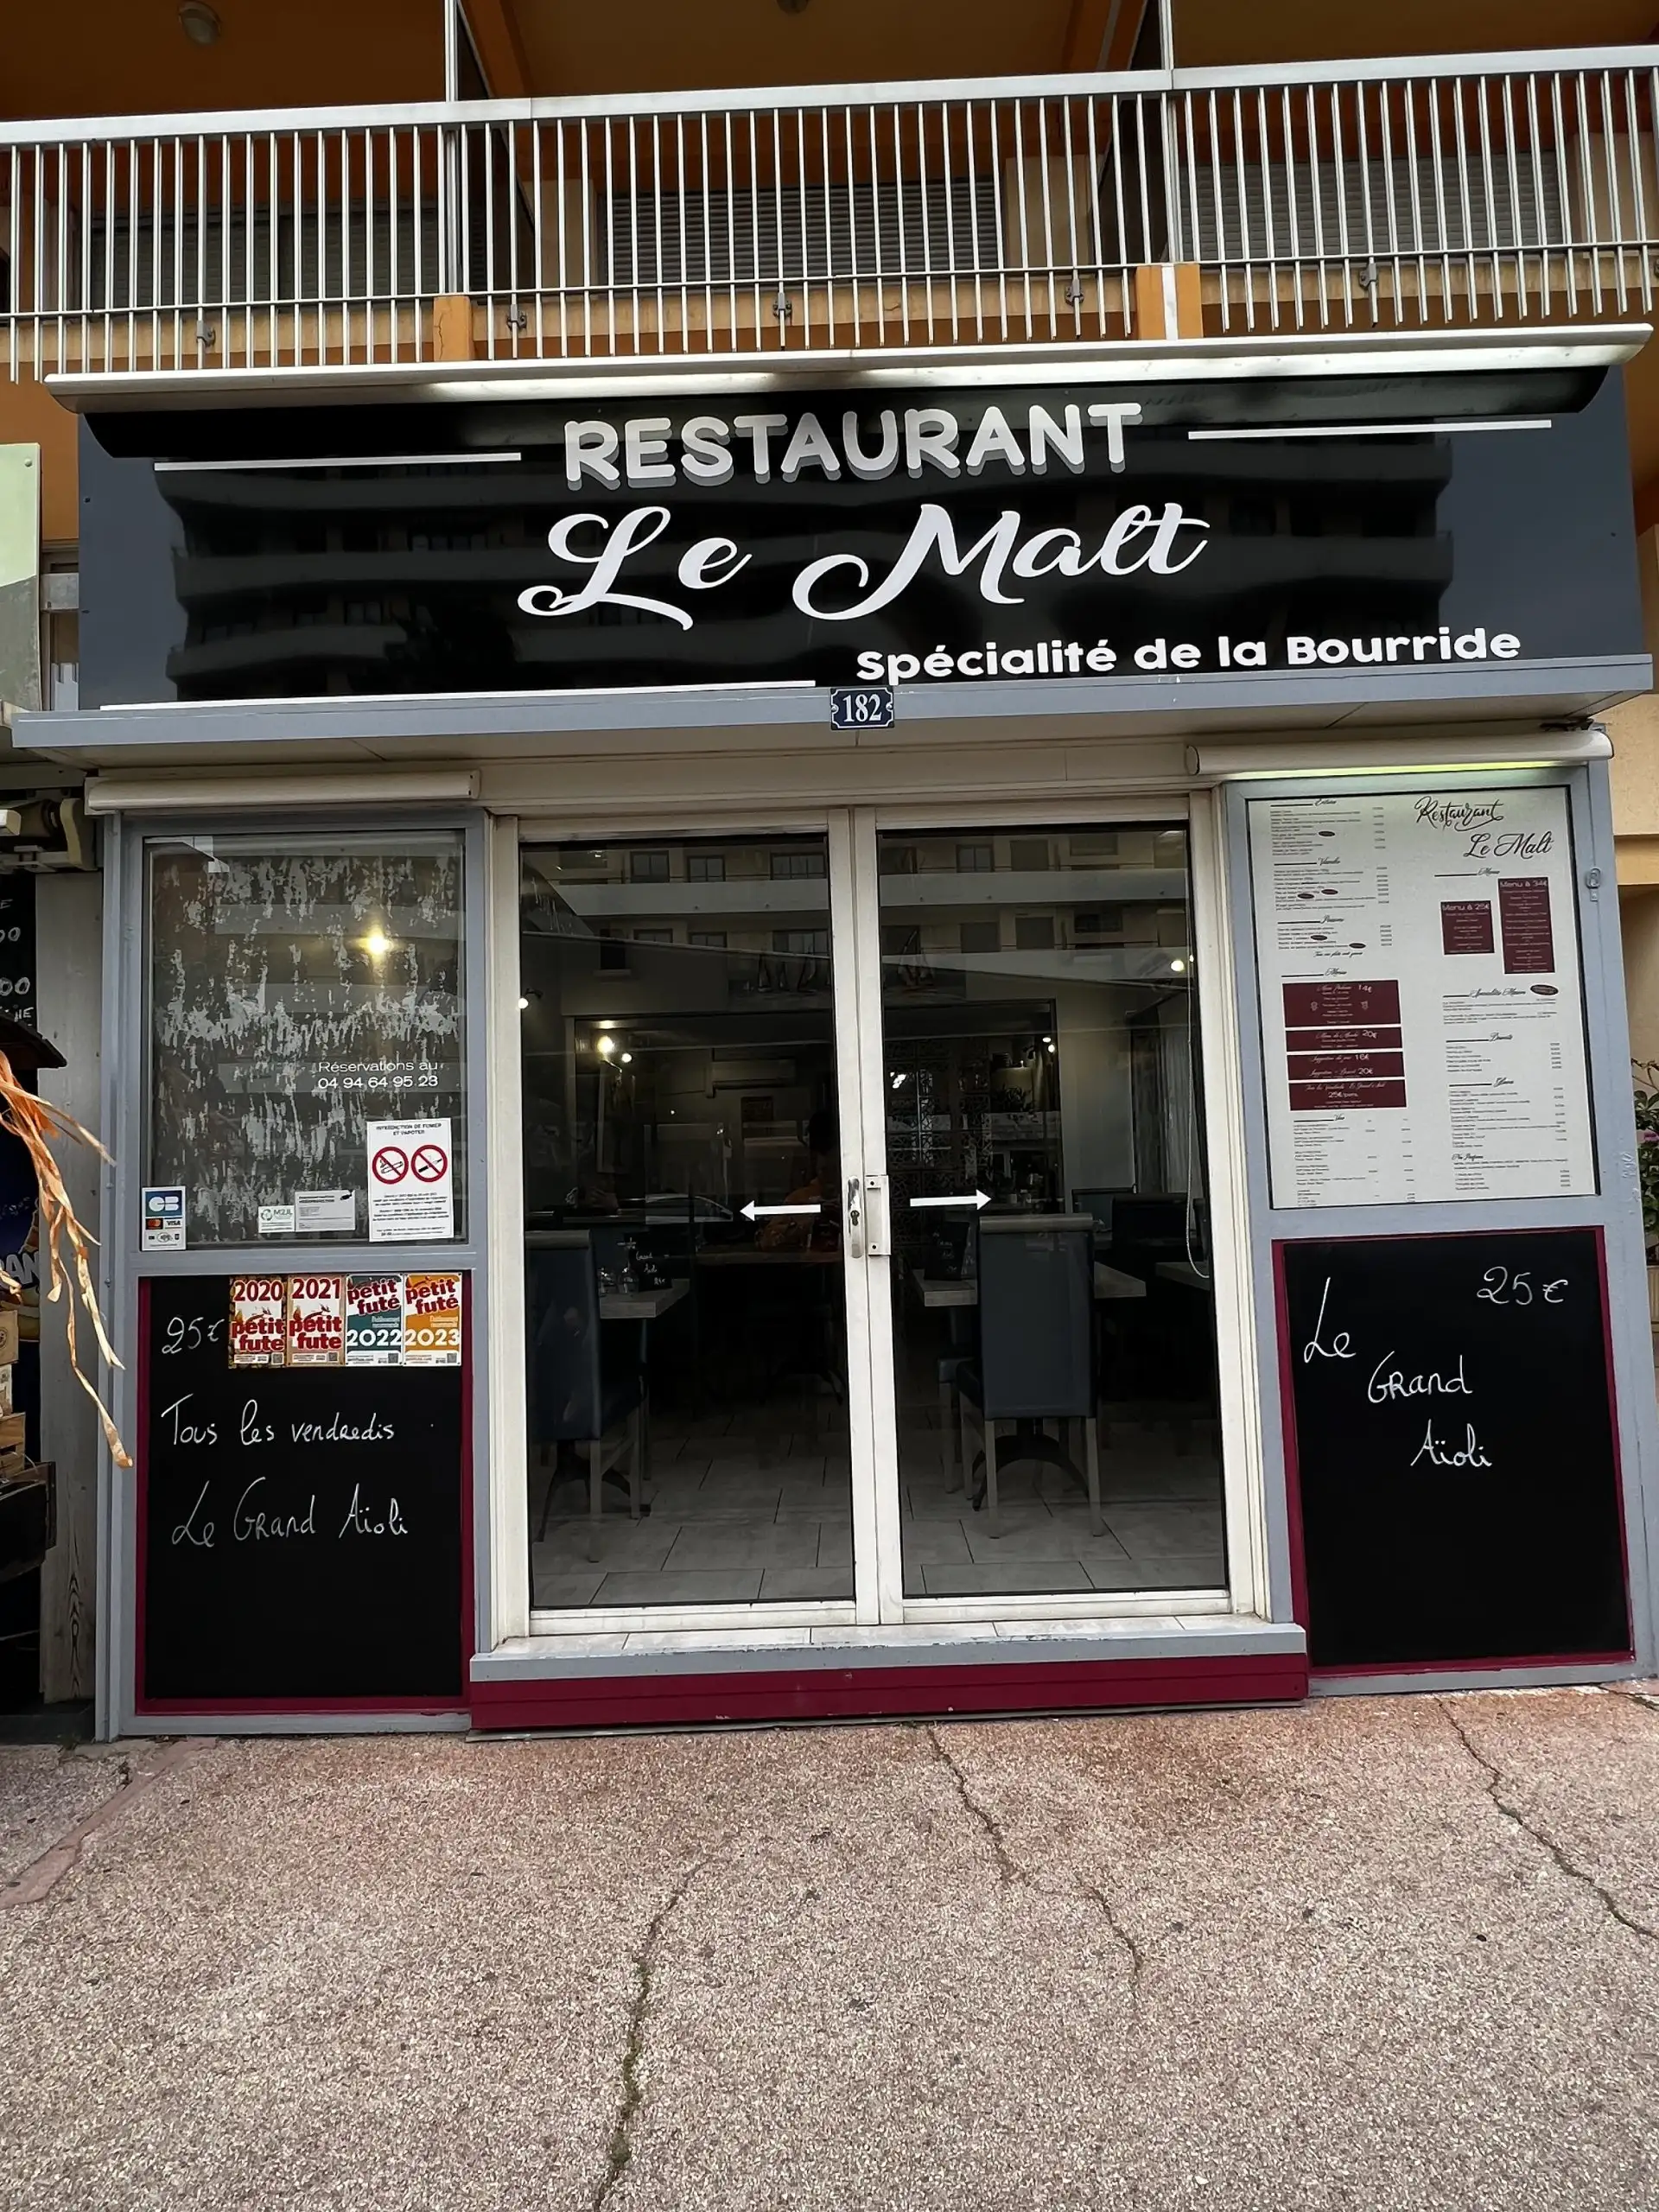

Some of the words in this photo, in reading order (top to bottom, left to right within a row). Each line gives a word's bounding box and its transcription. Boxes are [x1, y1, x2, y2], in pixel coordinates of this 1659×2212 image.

[564, 403, 1143, 489] RESTAURANT
[518, 506, 753, 632] Le
[791, 503, 1211, 620] Malt
[856, 639, 1117, 686] Spécialité
[1134, 638, 1202, 670] de
[1218, 635, 1267, 667] la
[1287, 626, 1522, 665] Bourride
[841, 694, 882, 722] 182
[1414, 796, 1504, 832] Restaurant
[1463, 833, 1492, 859] Le
[1493, 831, 1554, 859] Malt
[318, 1061, 415, 1072] Réservations
[419, 1062, 438, 1071] au
[318, 1077, 339, 1089] 04
[343, 1077, 364, 1089] 94
[368, 1077, 389, 1089] 64
[392, 1075, 413, 1087] 95
[418, 1075, 438, 1087] 23
[233, 1281, 283, 1301] 2020
[291, 1278, 341, 1300] 2021
[347, 1278, 397, 1305] petit
[405, 1278, 456, 1305] petit
[357, 1294, 400, 1315] futé
[416, 1294, 459, 1315] futé
[232, 1318, 284, 1338] petit
[289, 1315, 342, 1337] petit
[1303, 1276, 1357, 1363] Le
[346, 1329, 402, 1346] 2022
[404, 1329, 460, 1346] 2023
[161, 1393, 218, 1446] Tous
[240, 1399, 275, 1446] les
[172, 1480, 215, 1547] Le
